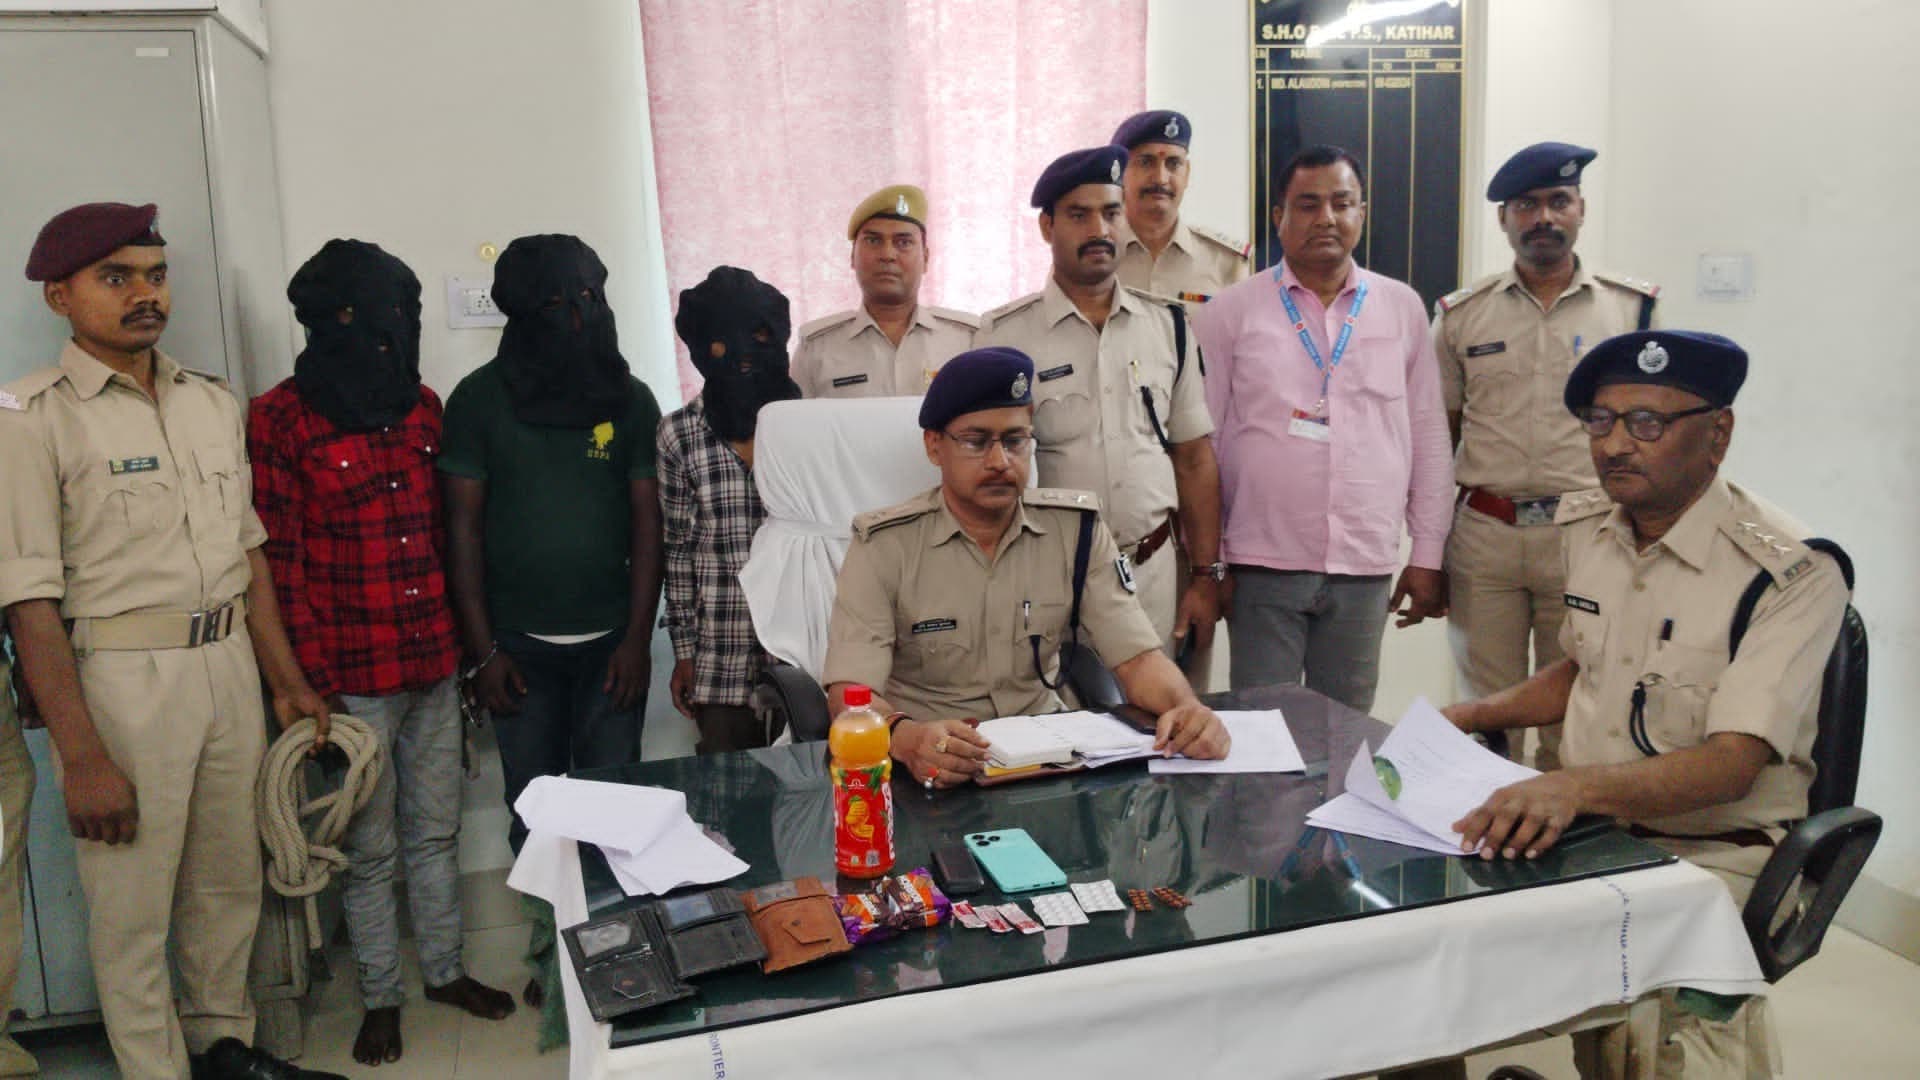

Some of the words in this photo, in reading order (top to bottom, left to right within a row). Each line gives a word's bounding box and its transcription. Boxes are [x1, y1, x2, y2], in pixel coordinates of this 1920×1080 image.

[1262, 24, 1306, 40] S.H.O
[1386, 24, 1455, 40] KATIHAR
[1405, 48, 1431, 58] DATE
